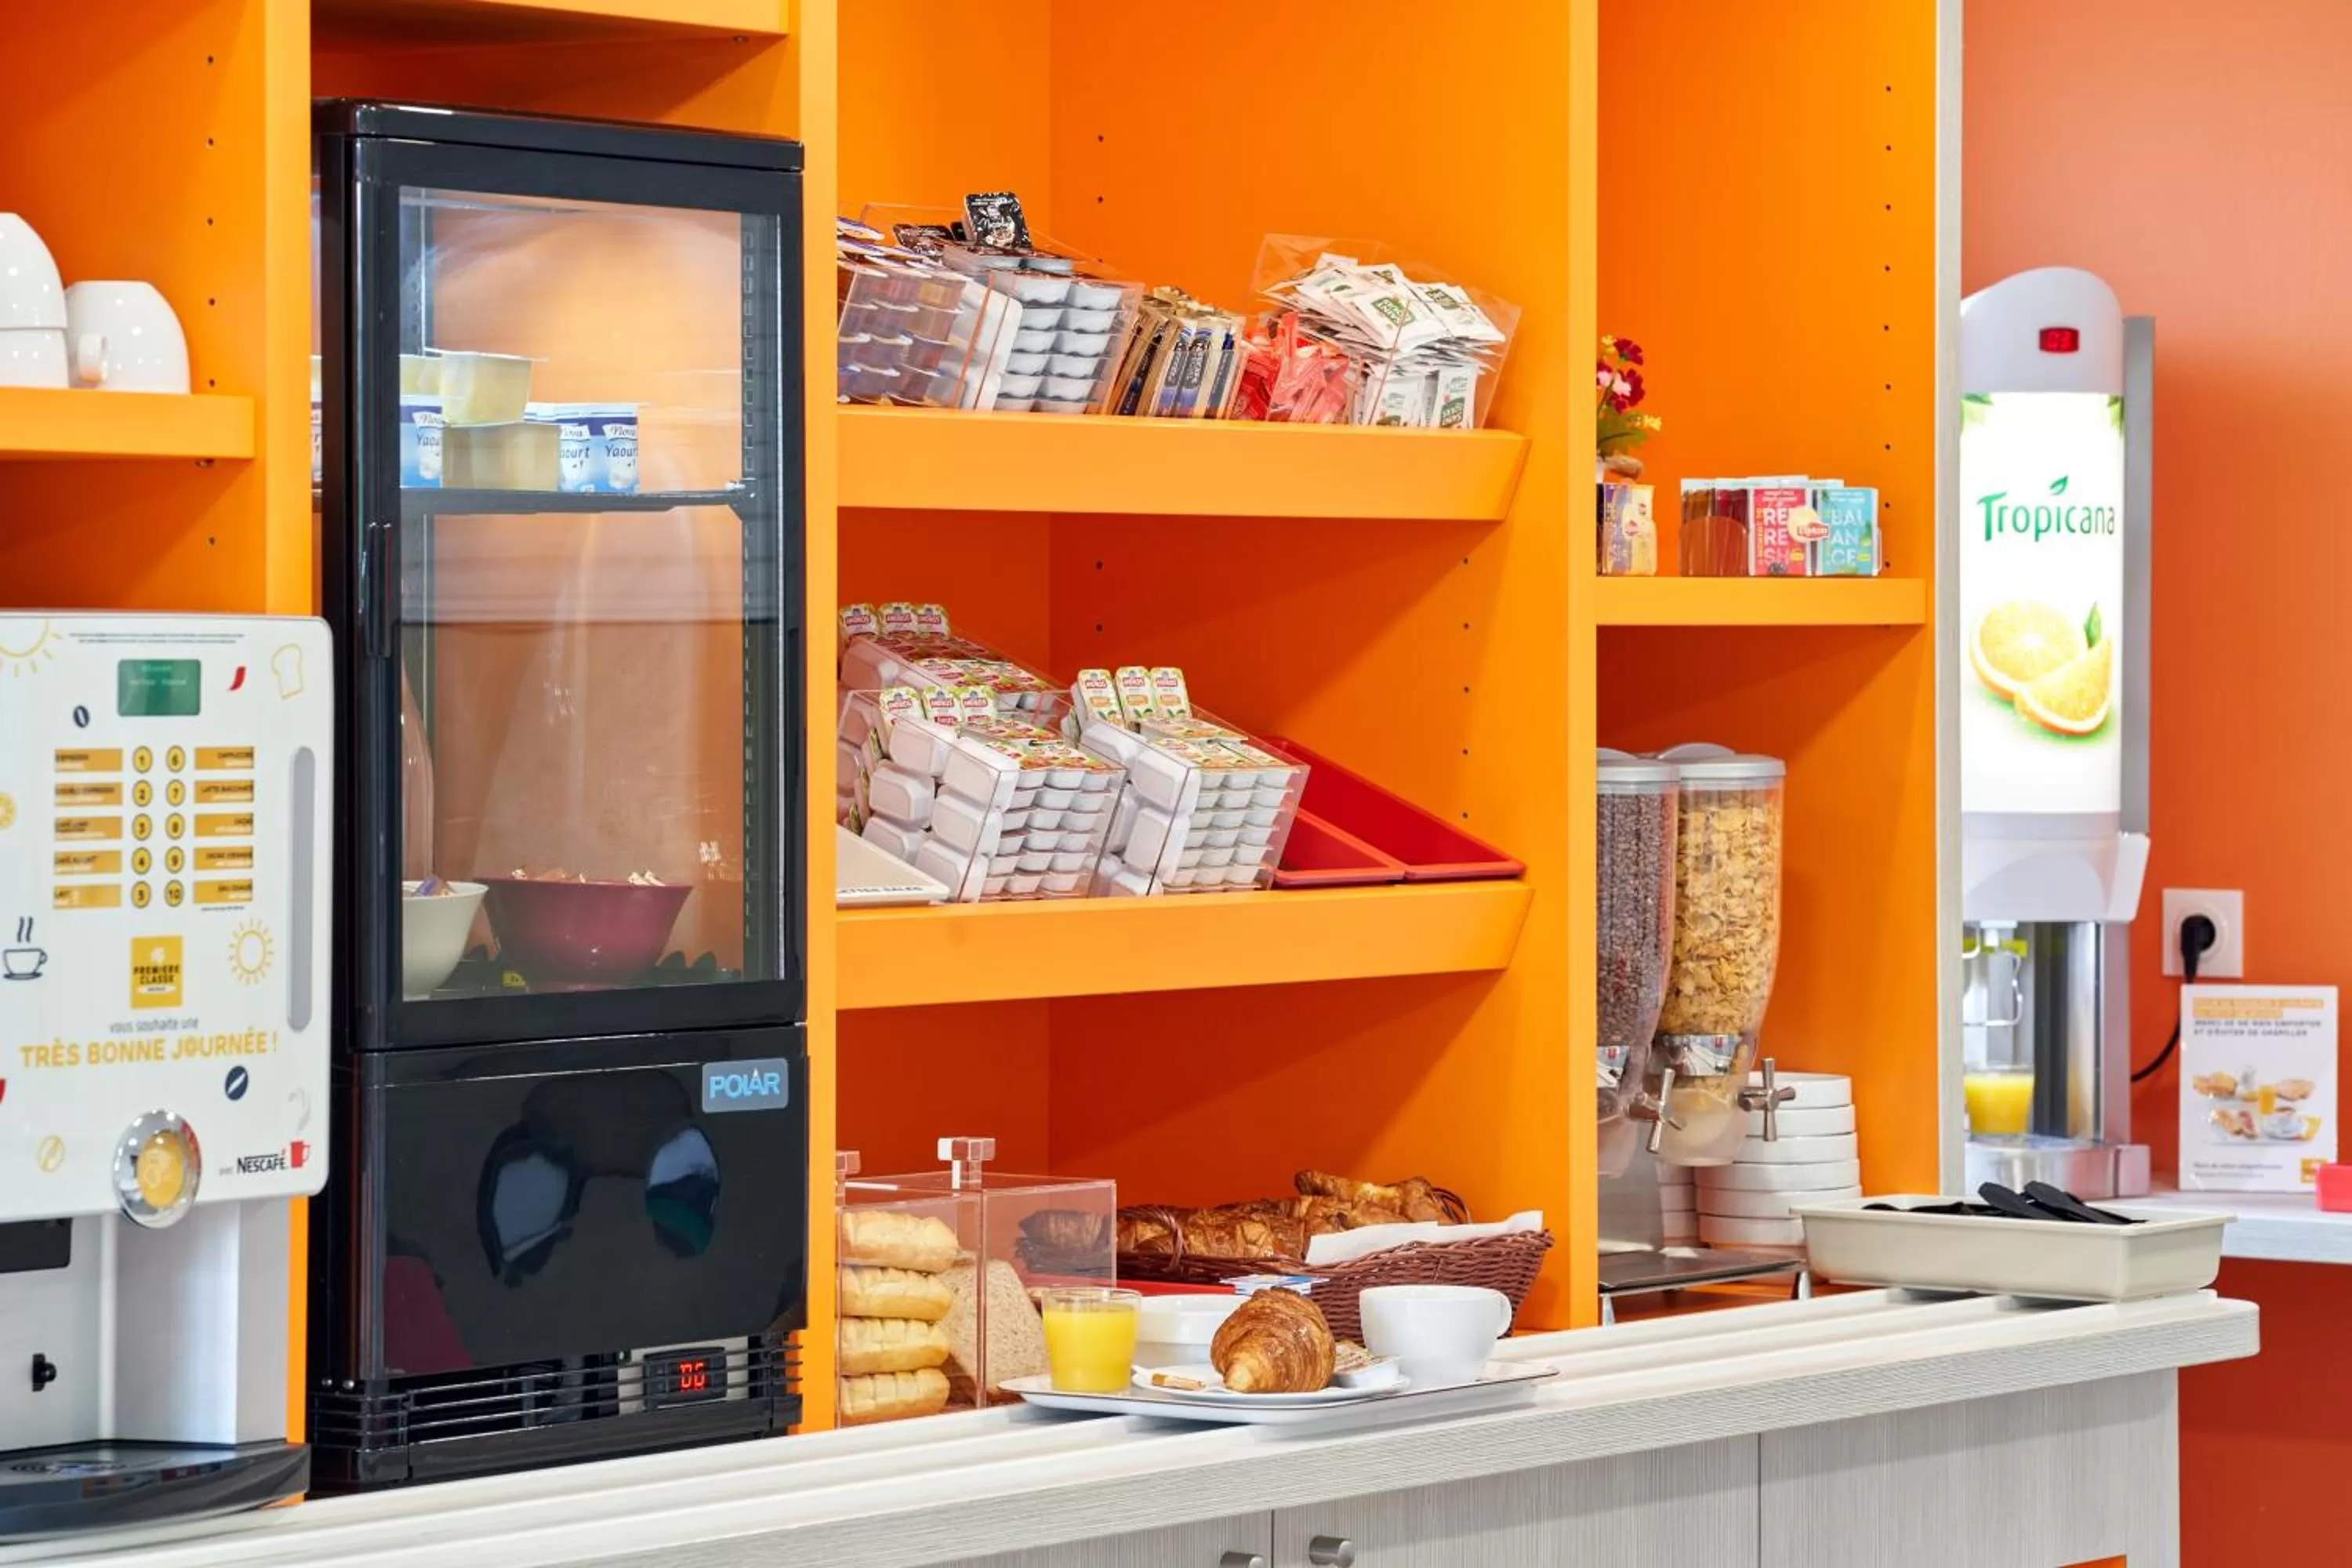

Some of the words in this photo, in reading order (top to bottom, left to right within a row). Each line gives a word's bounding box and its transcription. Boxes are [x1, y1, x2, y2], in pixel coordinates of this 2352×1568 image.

[1976, 474, 2115, 543] Tropicana
[1831, 529, 1859, 546] AN
[1832, 549, 1857, 566] CE
[168, 887, 182, 901] 10
[140, 975, 174, 985] CLASSE
[20, 1038, 81, 1067] TRÈS
[87, 1038, 165, 1065] BONNE
[171, 1026, 267, 1060] JOURNÉE
[709, 1067, 780, 1100] POLAR
[235, 1147, 285, 1174] NESCAFÉ
